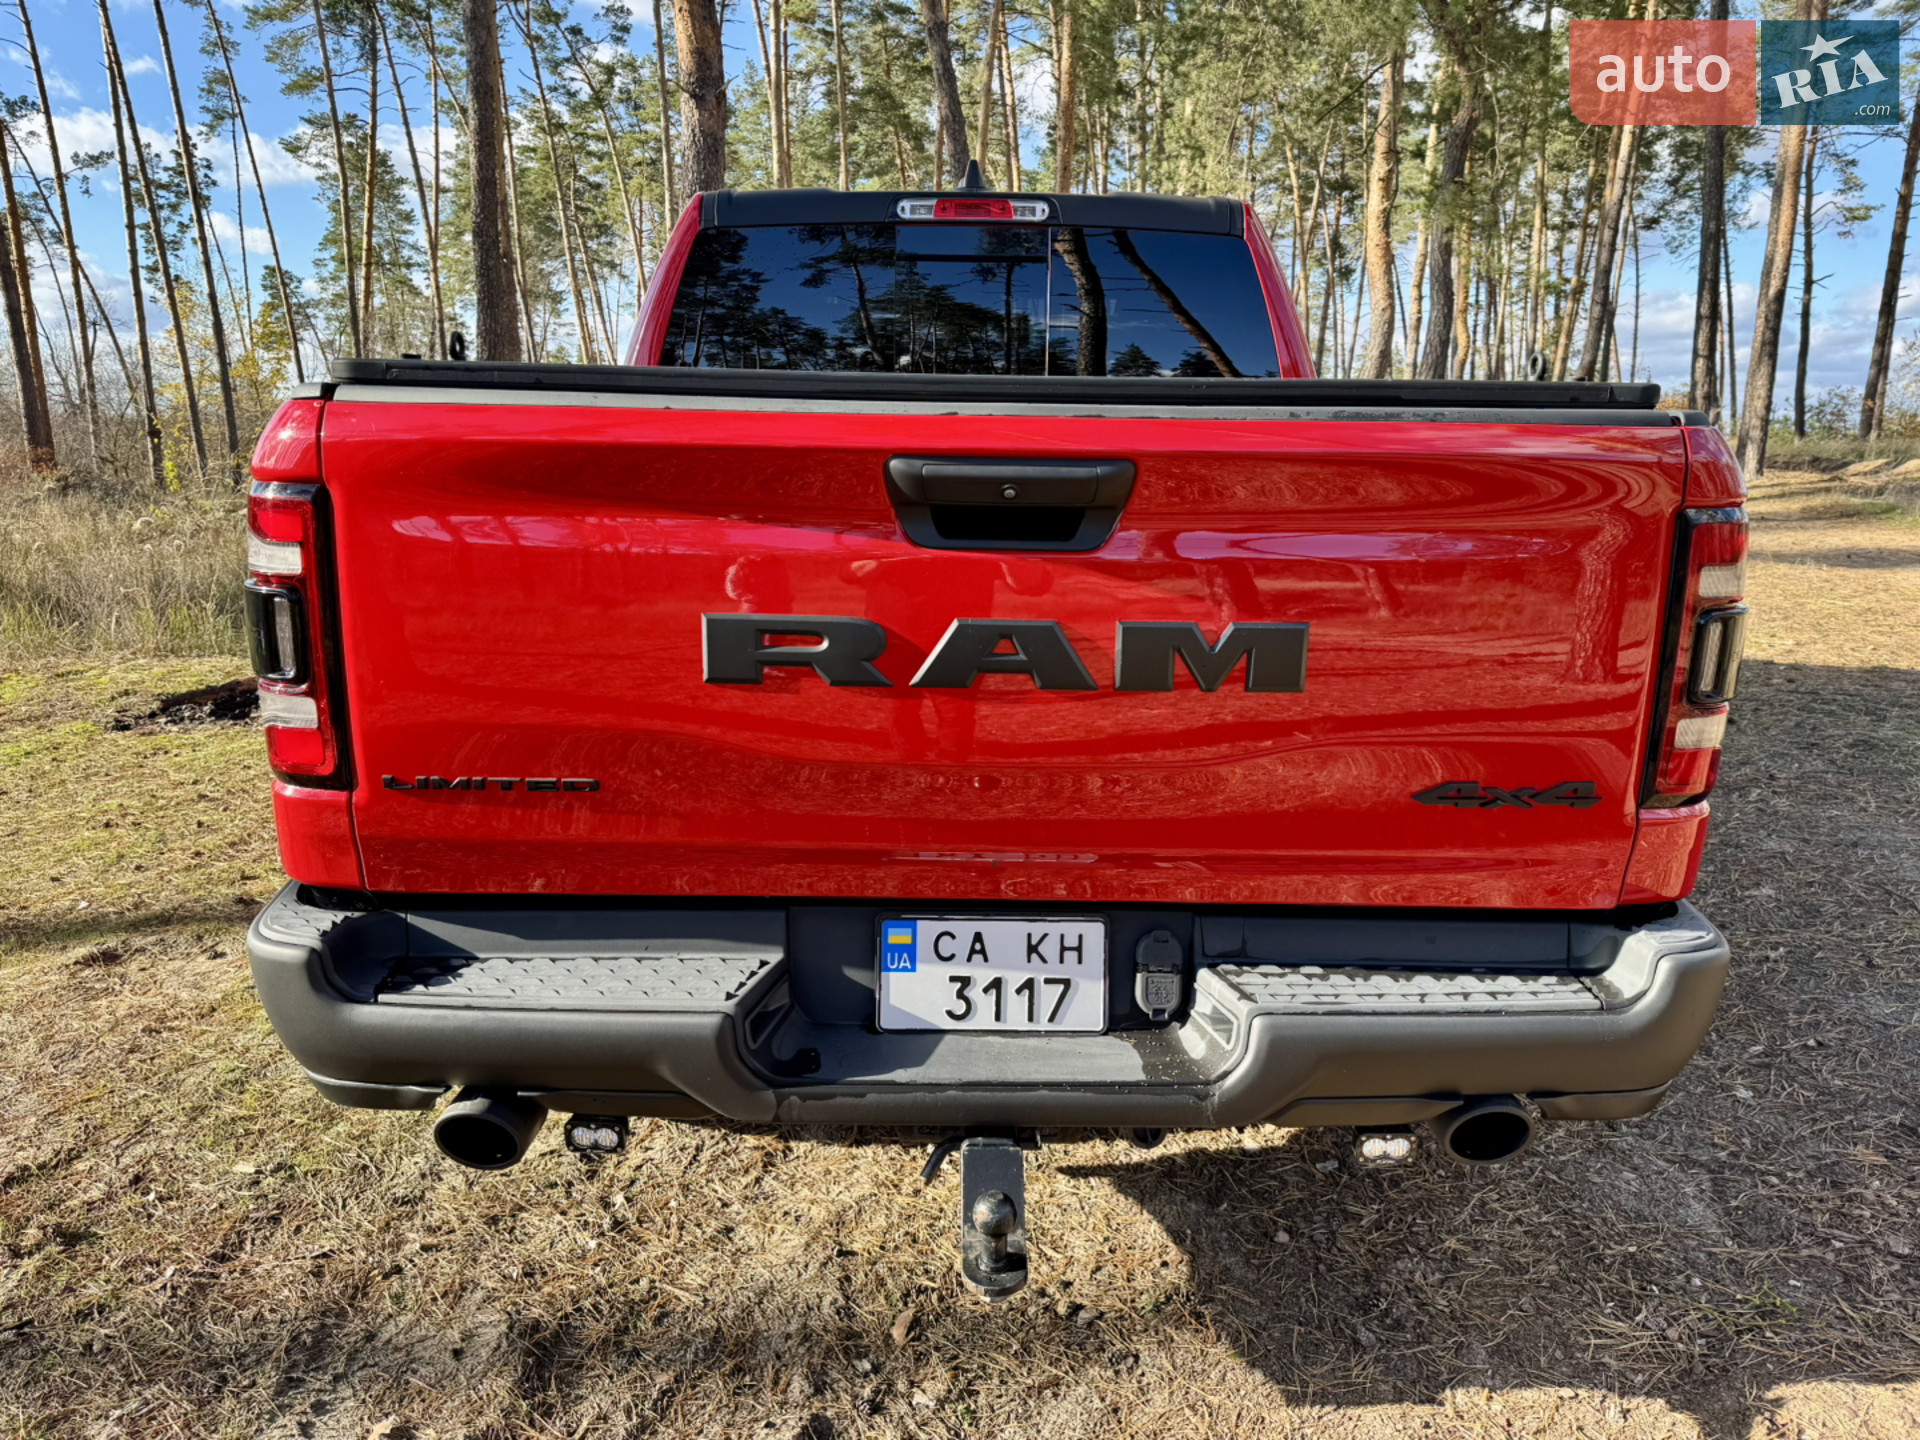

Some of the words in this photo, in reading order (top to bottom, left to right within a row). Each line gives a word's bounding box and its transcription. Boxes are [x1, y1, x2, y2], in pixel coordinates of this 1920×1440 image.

[701, 613, 1309, 692] RAM
[382, 774, 600, 792] LIMITED
[887, 952, 911, 969] UA
[932, 930, 989, 963] CA
[1026, 932, 1083, 965] KH
[944, 975, 1072, 1023] 3117
